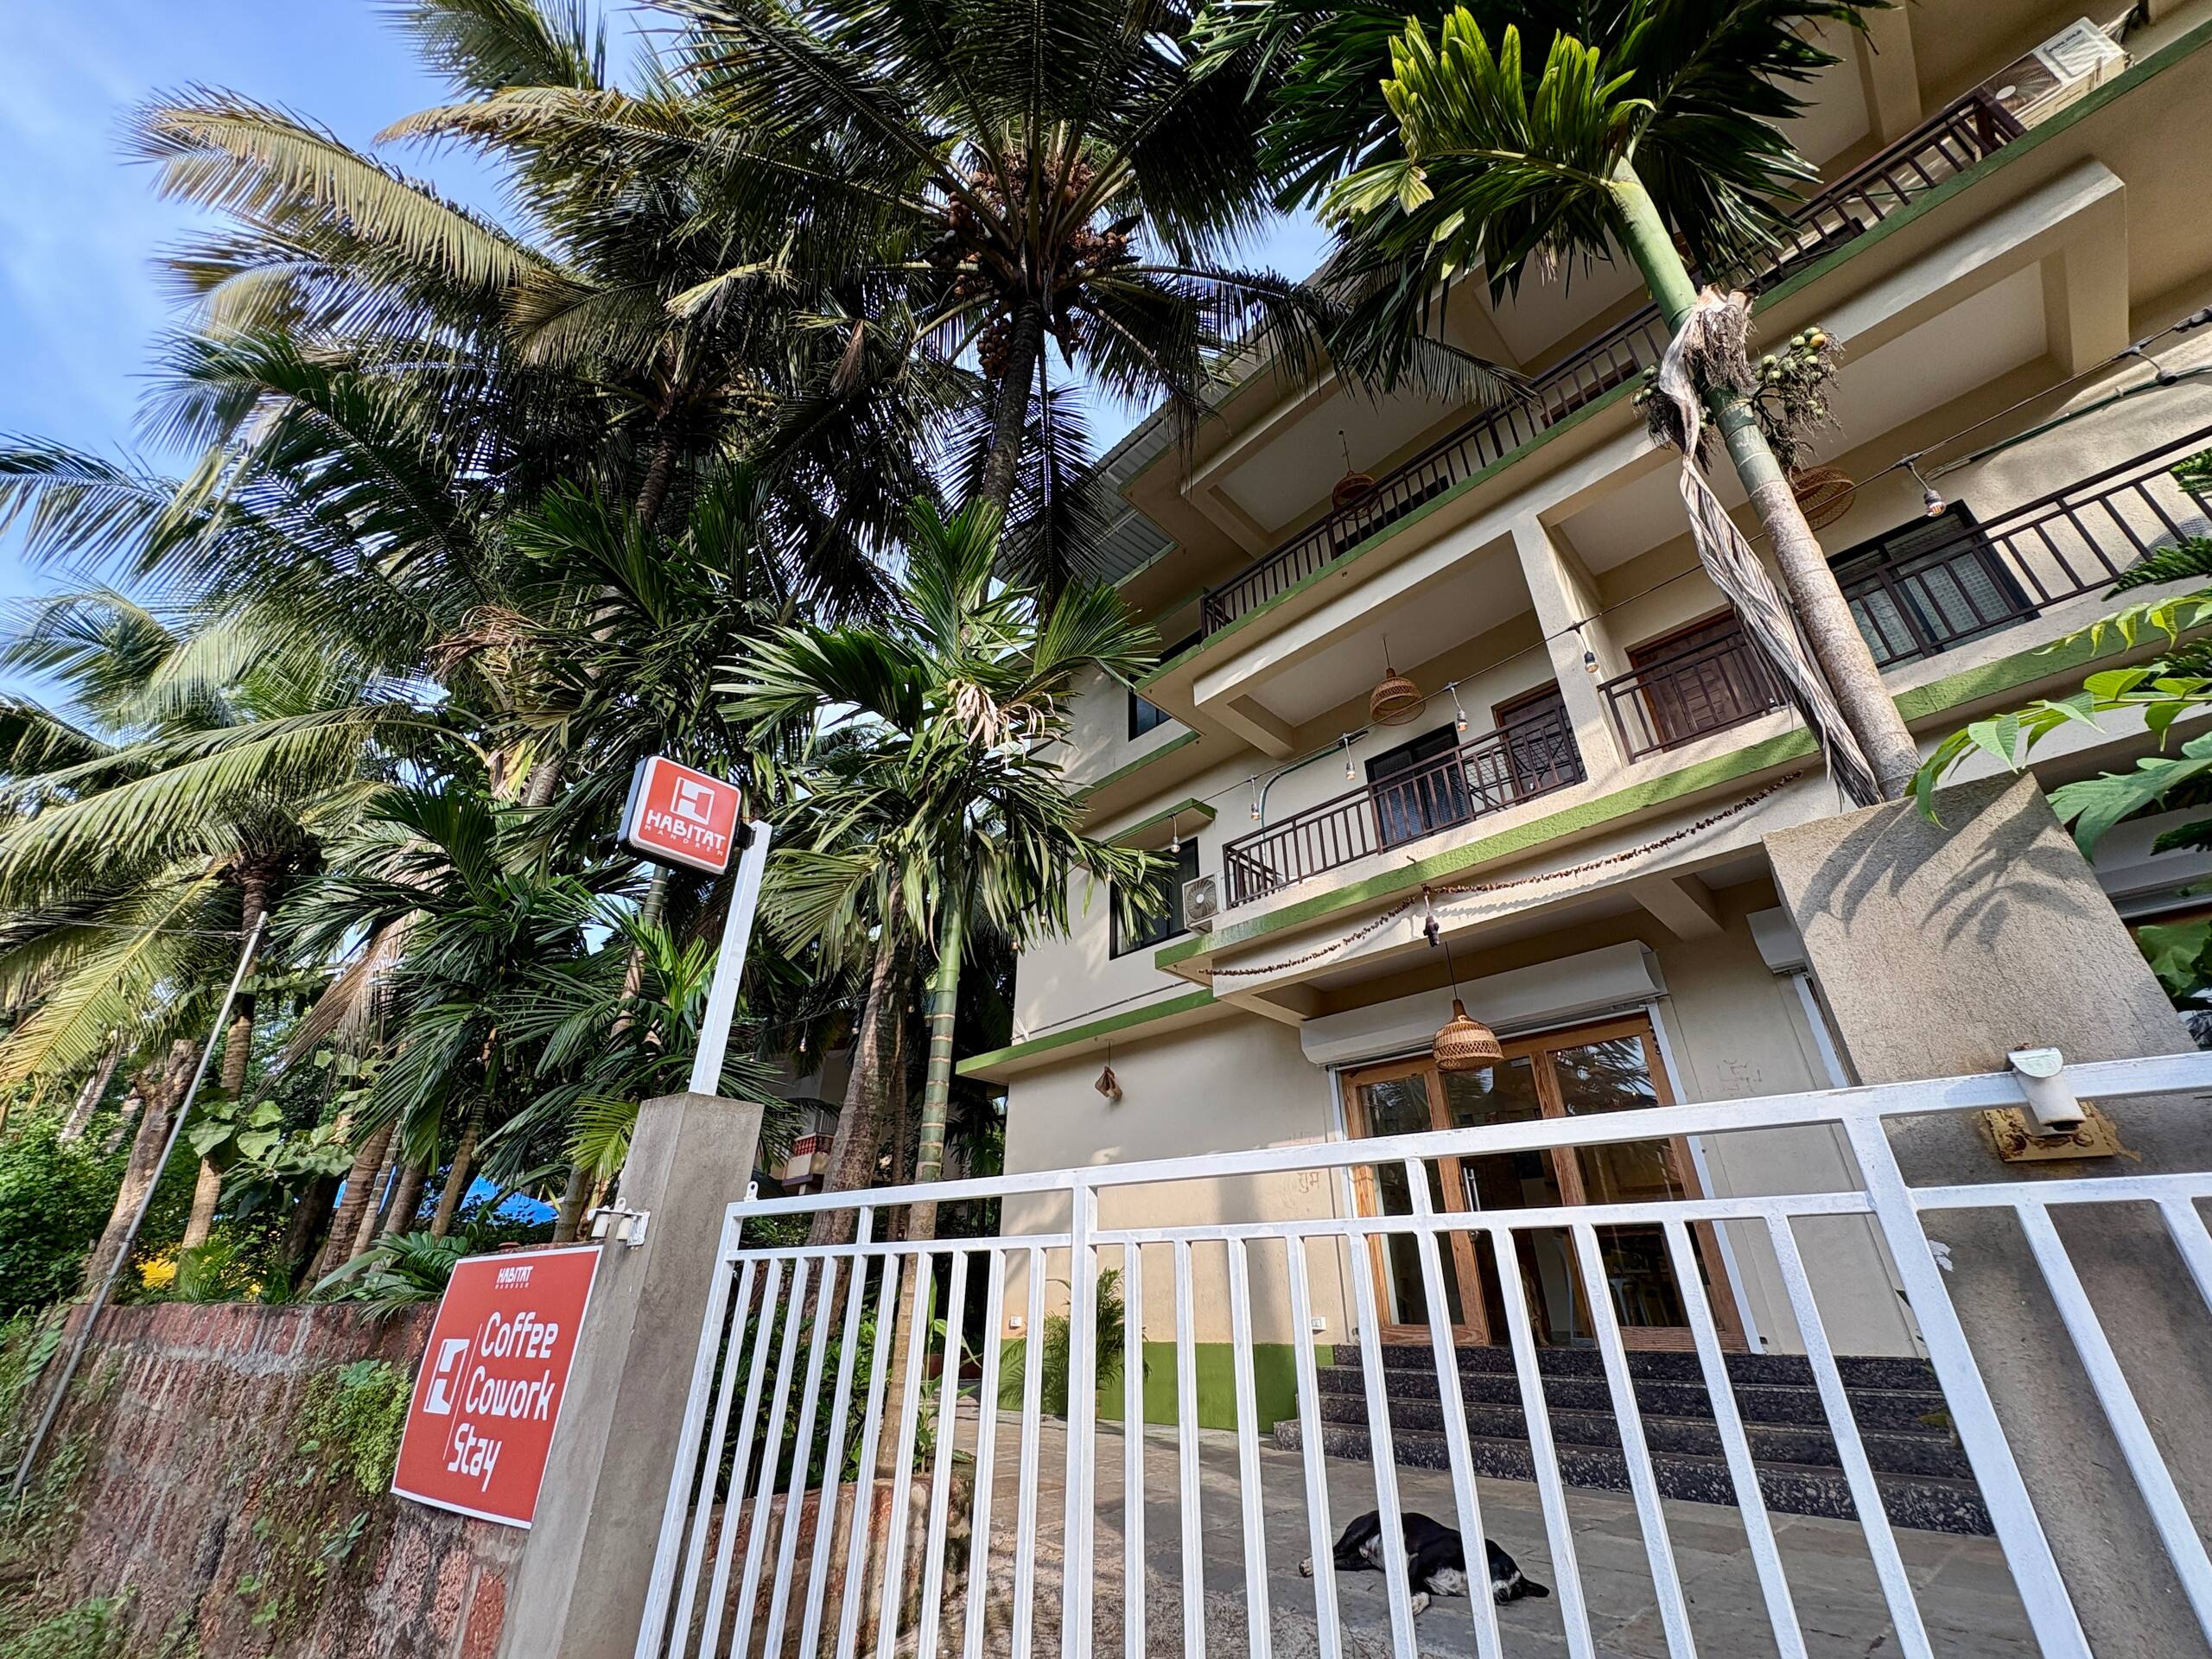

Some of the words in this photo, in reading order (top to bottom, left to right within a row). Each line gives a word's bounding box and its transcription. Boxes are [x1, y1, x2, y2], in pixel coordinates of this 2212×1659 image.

[645, 824, 723, 857] MANDREM
[646, 809, 727, 849] HABITAT
[496, 1266, 534, 1284] HABITAT
[480, 1311, 559, 1358] Coffee
[465, 1365, 556, 1421] Cowork
[448, 1422, 503, 1493] Stay
